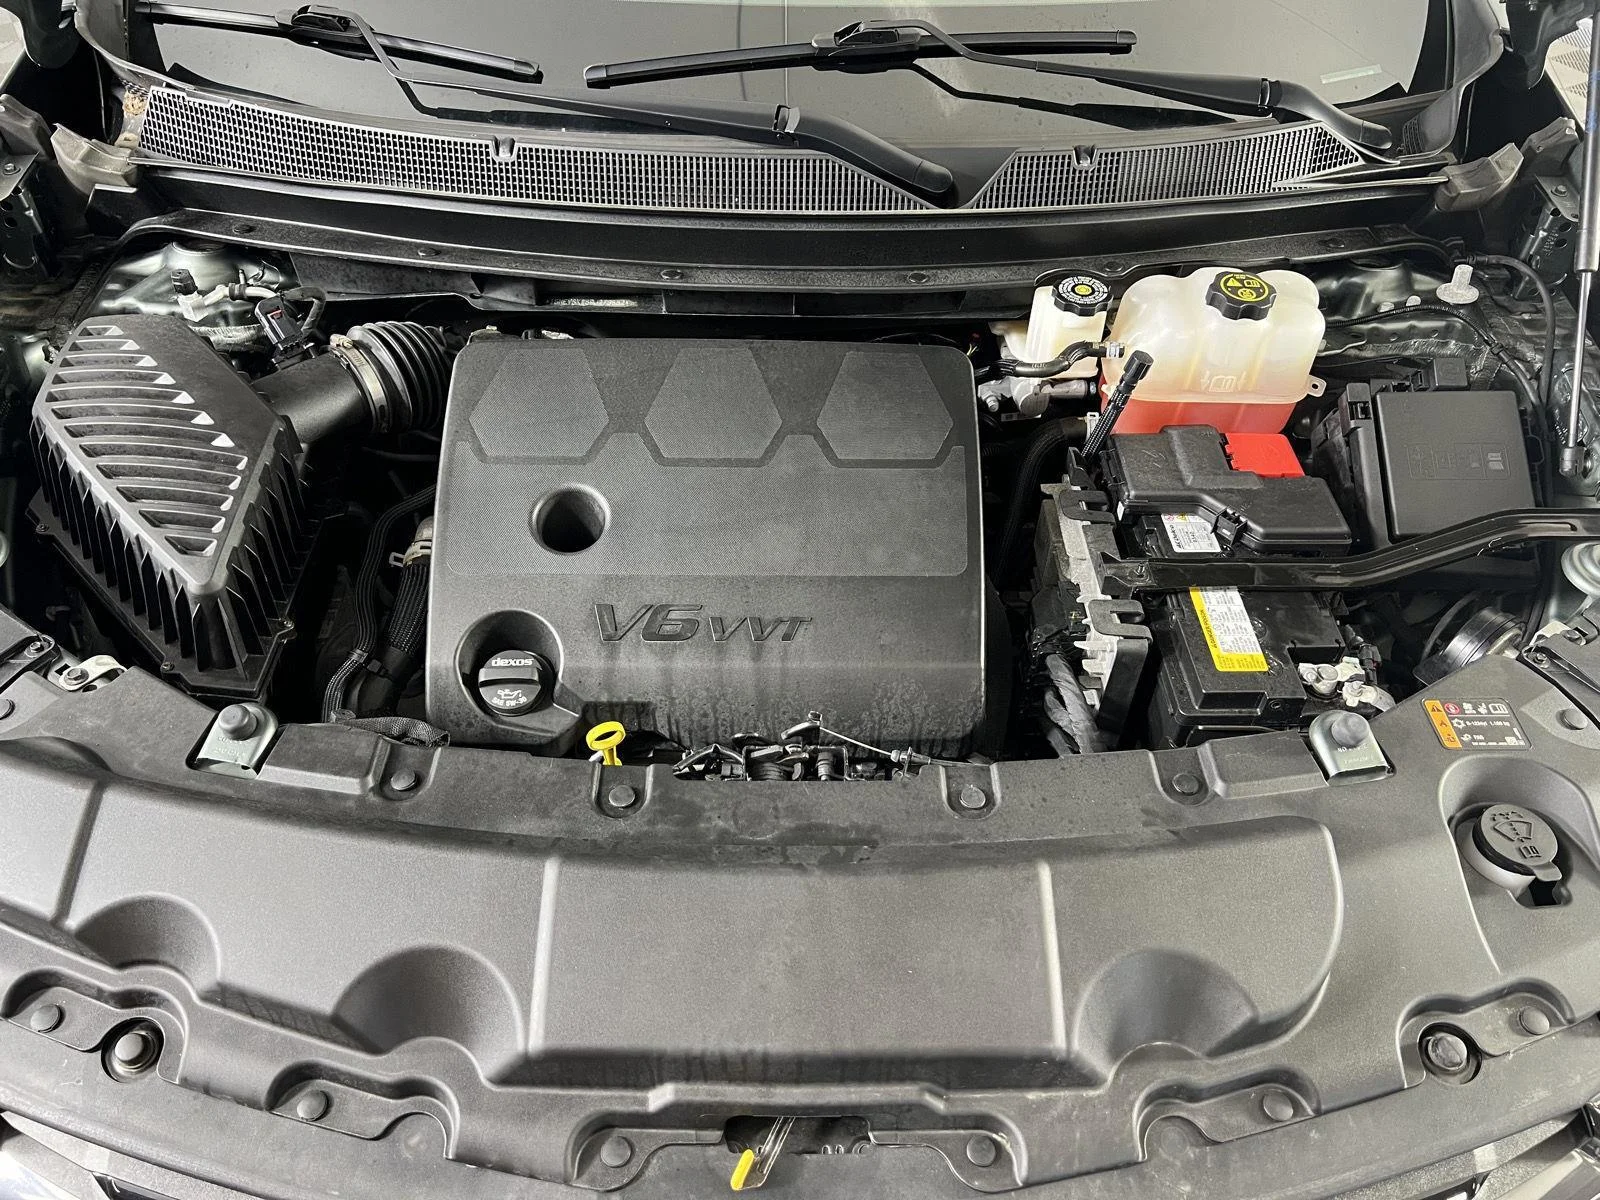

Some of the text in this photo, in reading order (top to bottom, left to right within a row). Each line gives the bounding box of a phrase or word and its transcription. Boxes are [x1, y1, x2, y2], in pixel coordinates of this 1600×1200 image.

[594, 604, 812, 642] V6 VVT
[491, 657, 535, 667] dexos
[491, 696, 528, 707] SAE 5W-30
